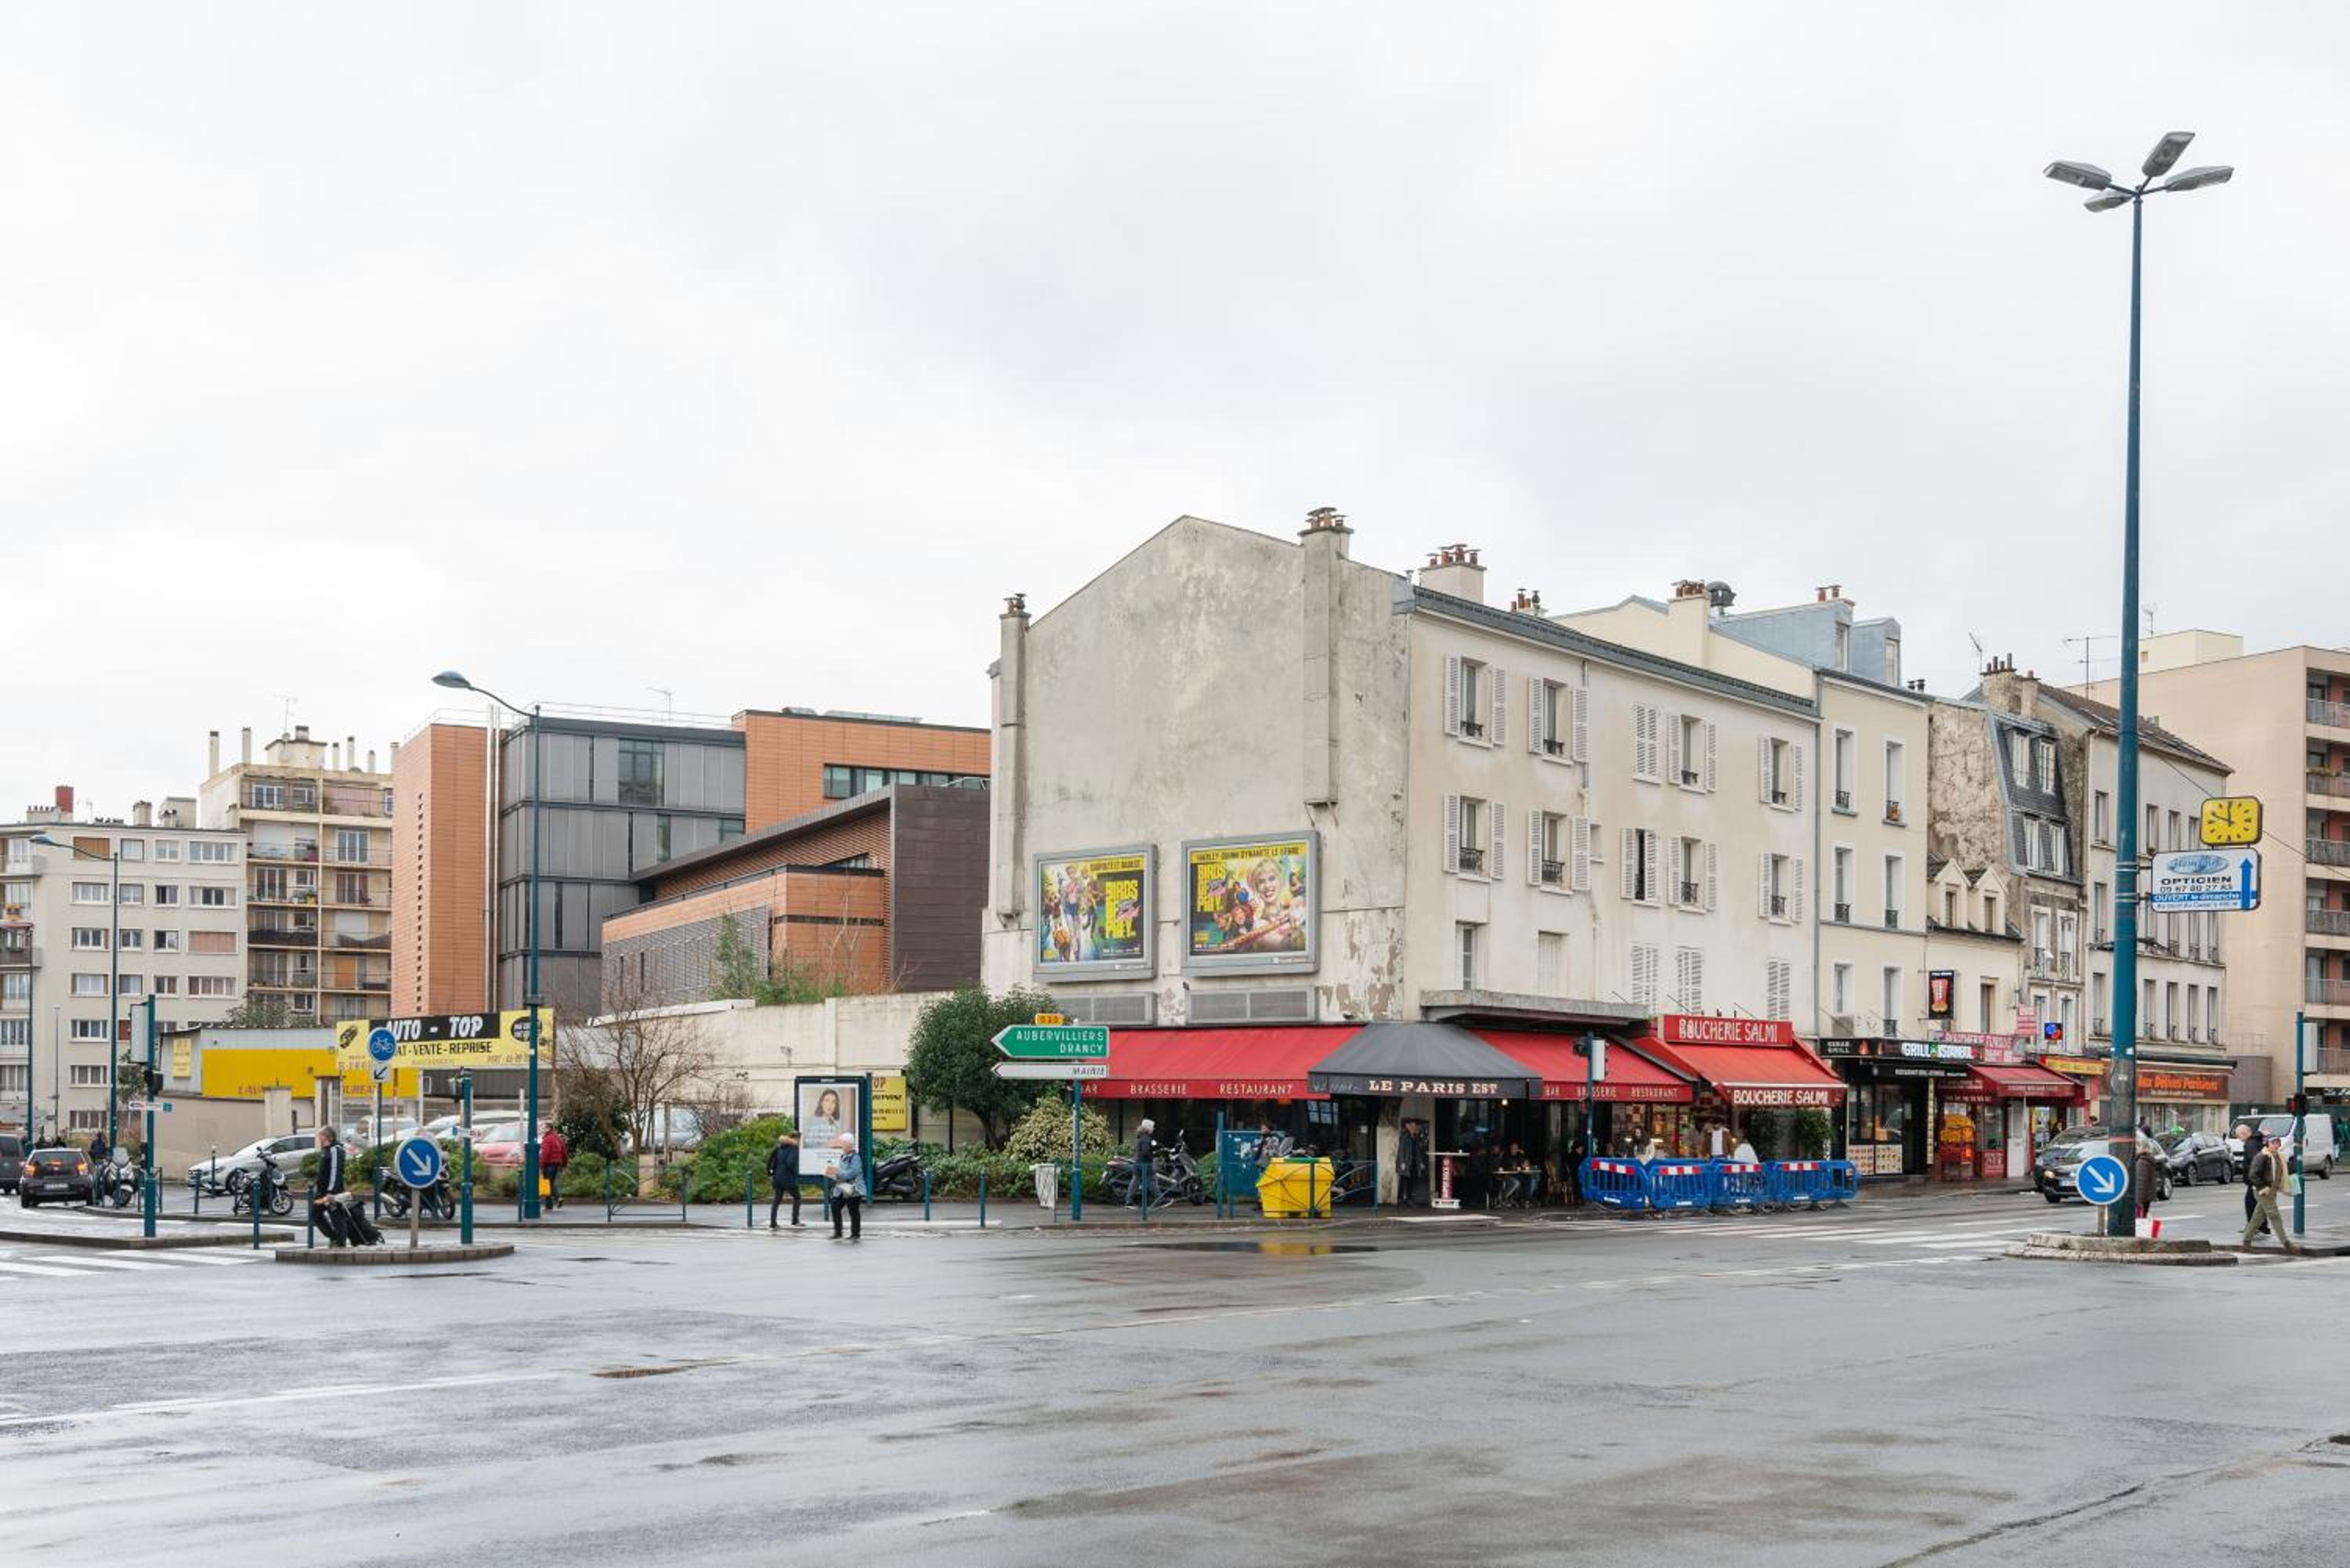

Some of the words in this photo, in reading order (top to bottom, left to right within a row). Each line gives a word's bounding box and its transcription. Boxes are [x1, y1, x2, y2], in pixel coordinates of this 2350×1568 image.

[1198, 864, 1226, 880] BIRDS
[2161, 876, 2232, 885] OPTICIEN
[1105, 880, 1138, 900] BIRDS
[449, 1016, 483, 1038] TOP
[1679, 1020, 1741, 1041] BOUCHERIE
[1745, 1022, 1777, 1042] SALMI
[1016, 1030, 1104, 1041] AUBERVILLIERS
[397, 1041, 493, 1056] AT-VENTE-REPRISE
[1060, 1042, 1104, 1053] DRANCY
[1904, 1042, 1930, 1057] GRILL
[1072, 1067, 1105, 1076] MAIRIE
[873, 1078, 886, 1089] OP
[1085, 1084, 1097, 1093] AR
[1130, 1084, 1187, 1095] BRASSERIE
[1220, 1083, 1293, 1095] RESTAURANT
[1368, 1080, 1392, 1091] LE
[1401, 1081, 1466, 1093] PARIS
[1472, 1082, 1499, 1094] EST
[1545, 1085, 1560, 1096] BAR
[1577, 1086, 1617, 1097] BRSSERIE
[1631, 1087, 1679, 1098] RESTAURANT
[1734, 1089, 1794, 1105] BOUCHERIE
[1795, 1089, 1828, 1105] SALMI
